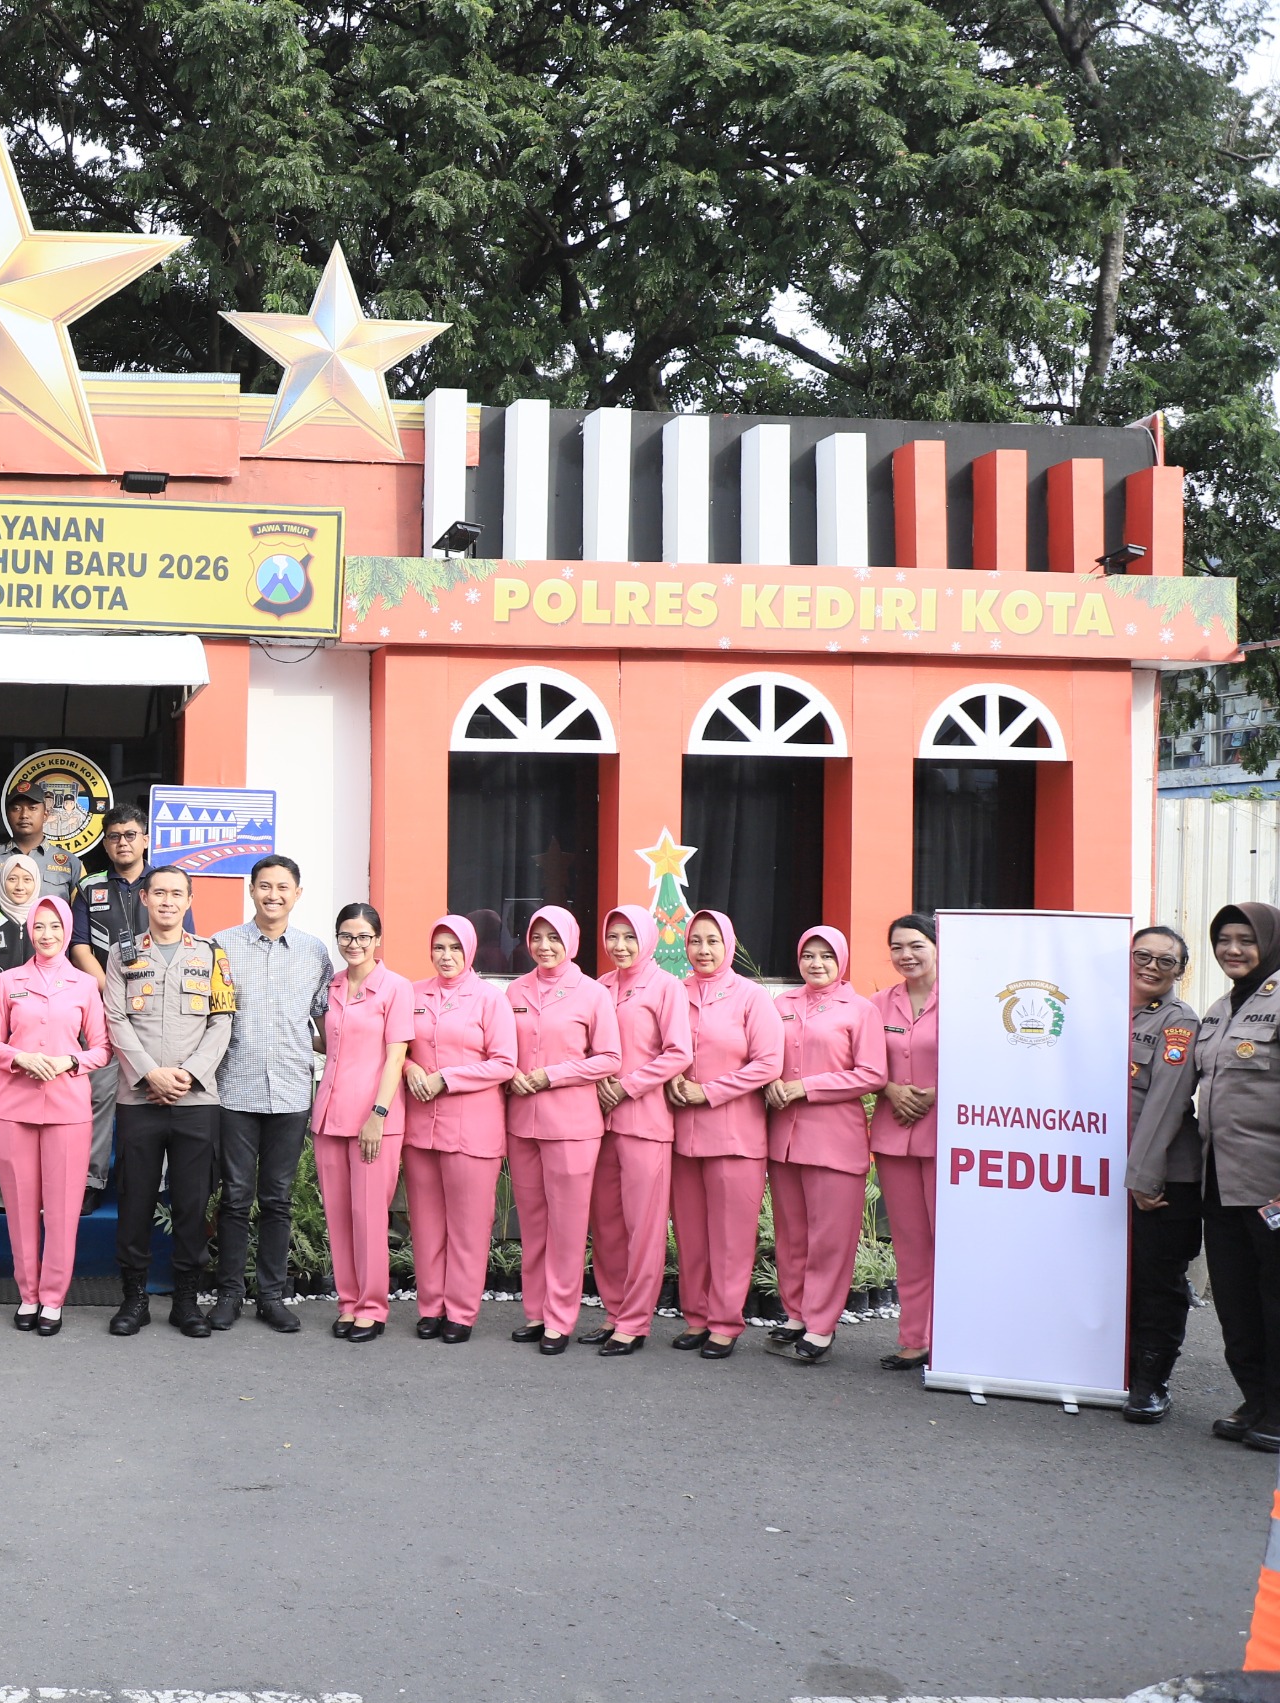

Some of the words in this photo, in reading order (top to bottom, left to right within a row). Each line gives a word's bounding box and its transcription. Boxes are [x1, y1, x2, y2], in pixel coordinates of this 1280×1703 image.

[256, 524, 281, 534] JAWA
[282, 524, 310, 536] TIMUR
[65, 550, 149, 579] BARU
[157, 553, 230, 582] 2026
[52, 584, 129, 612] KOTA
[493, 577, 719, 628] POLRES
[740, 583, 938, 633] KEDIRI
[961, 589, 1115, 637] KOTA
[49, 759, 79, 769] KEDIRI
[79, 767, 98, 787] KOTA
[183, 968, 210, 978] POLRI
[1008, 981, 1057, 991] BHAYANGKARI
[1243, 1014, 1276, 1023] POLRI
[957, 1104, 1107, 1134] BHAYANGKARI
[950, 1147, 1110, 1197] PEDULI
